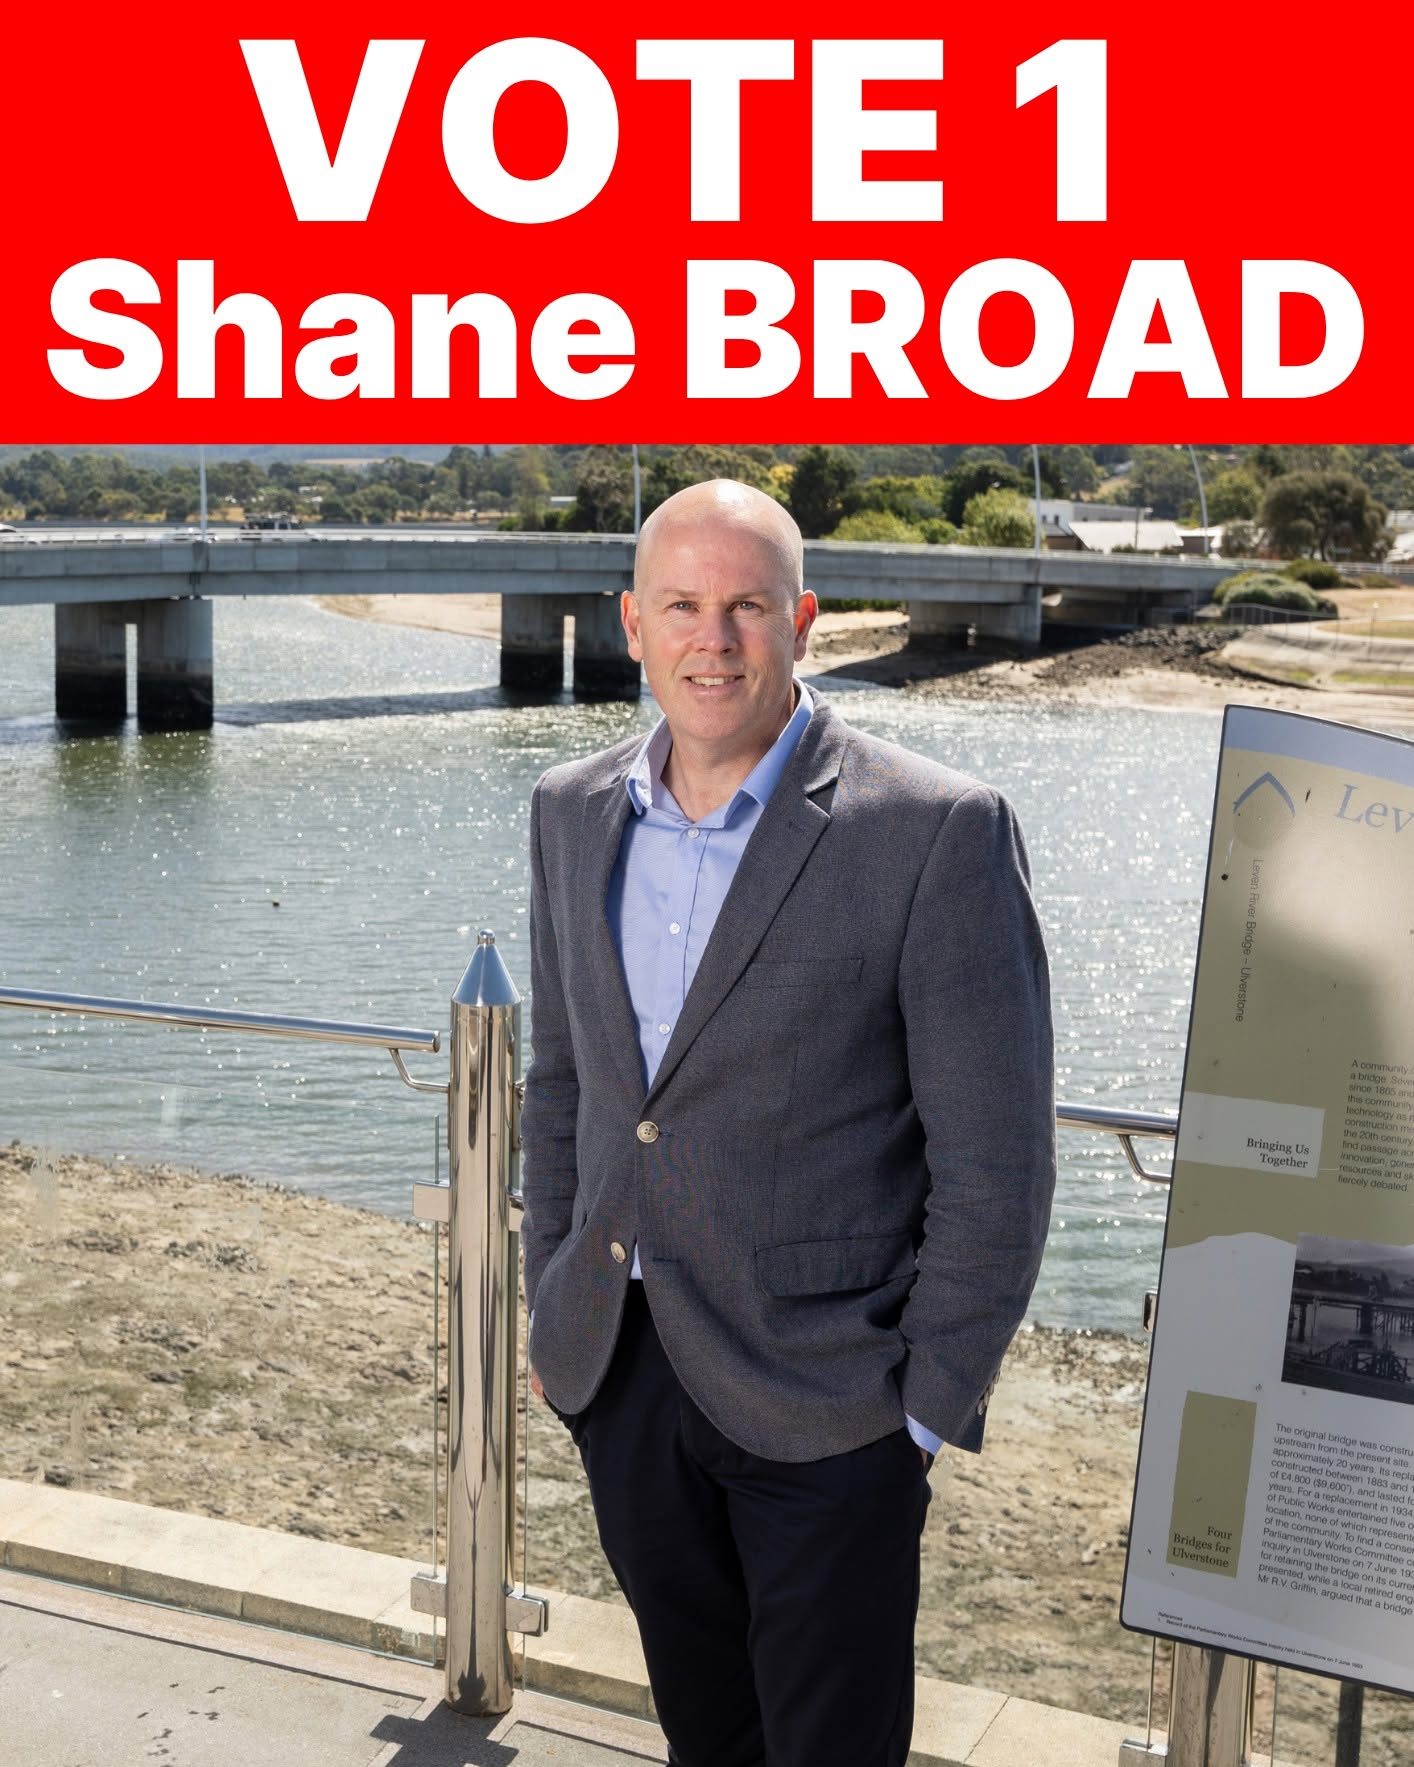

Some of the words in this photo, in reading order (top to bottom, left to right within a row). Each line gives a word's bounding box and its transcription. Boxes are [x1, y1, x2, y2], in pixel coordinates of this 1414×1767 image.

[1250, 859, 1264, 890] Leven
[1247, 893, 1259, 918] River
[1242, 921, 1256, 956] Bridge
[1235, 967, 1251, 1022] Ulverstone
[1350, 1072, 1356, 1080] a
[1352, 1059, 1358, 1068] A
[1361, 1062, 1408, 1075] community
[1348, 1095, 1363, 1103] this
[1349, 1084, 1371, 1093] since
[1345, 1119, 1398, 1132] construction
[1346, 1106, 1394, 1120] technology
[1246, 1138, 1292, 1154] Bringing
[1296, 1144, 1309, 1154] Us
[1344, 1129, 1357, 1138] the
[1360, 1131, 1379, 1141] 20th
[1260, 1152, 1308, 1168] Together
[1343, 1140, 1359, 1149] find
[1361, 1144, 1399, 1156] passage
[1338, 1174, 1368, 1188] fiercely
[1340, 1165, 1382, 1177] resources
[1384, 1170, 1402, 1179] and
[1276, 1423, 1292, 1434] The
[1294, 1428, 1326, 1440] original
[1328, 1434, 1357, 1447] bridge
[1359, 1441, 1377, 1450] was
[1273, 1448, 1333, 1467] approximately
[1336, 1459, 1347, 1468] 20
[1379, 1467, 1390, 1477] Its
[1274, 1437, 1316, 1450] upstream
[1318, 1443, 1338, 1455] from
[1340, 1448, 1354, 1458] the
[1357, 1452, 1391, 1465] present
[1270, 1471, 1279, 1479] of
[1358, 1488, 1375, 1497] and
[1377, 1490, 1405, 1504] lasted
[1271, 1459, 1323, 1475] constructed
[1325, 1469, 1363, 1483] between
[1367, 1476, 1388, 1488] 1883
[1391, 1482, 1408, 1492] and
[1267, 1494, 1276, 1502] of
[1279, 1495, 1305, 1508] Public
[1307, 1502, 1335, 1514] Works
[1337, 1509, 1388, 1525] entertained
[1390, 1518, 1405, 1529] five
[1298, 1487, 1312, 1497] For
[1314, 1491, 1320, 1499] a
[1322, 1492, 1378, 1511] replacement
[1380, 1503, 1388, 1512] in
[1207, 1525, 1232, 1540] Four
[1264, 1517, 1273, 1525] of
[1275, 1518, 1289, 1528] the
[1345, 1532, 1355, 1541] To
[1357, 1534, 1373, 1545] find
[1305, 1514, 1328, 1524] none
[1330, 1517, 1339, 1526] of
[1341, 1521, 1366, 1533] which
[1174, 1533, 1212, 1550] Bridges
[1215, 1542, 1232, 1554] for
[1263, 1527, 1322, 1548] Parliamentary
[1324, 1539, 1352, 1553] Works
[1355, 1546, 1404, 1564] Committee
[1172, 1547, 1229, 1568] Ulverstone
[1260, 1551, 1272, 1560] for
[1274, 1555, 1312, 1570] retaining
[1314, 1563, 1328, 1572] the
[1331, 1566, 1360, 1579] bridge
[1362, 1573, 1373, 1582] on
[1376, 1575, 1386, 1585] its
[1262, 1540, 1291, 1553] inquiry
[1293, 1546, 1301, 1555] in
[1303, 1549, 1350, 1565] Ulverstone
[1352, 1560, 1364, 1569] on
[1374, 1564, 1397, 1575] June
[1258, 1574, 1269, 1584] Mr
[1271, 1576, 1288, 1588] R.V.
[1290, 1580, 1318, 1595] Griffin,
[1321, 1588, 1353, 1602] argued
[1356, 1595, 1372, 1607] that
[1383, 1601, 1413, 1616] bridge
[1307, 1573, 1331, 1585] while
[1332, 1579, 1339, 1587] a
[1341, 1581, 1362, 1592] local
[1364, 1586, 1393, 1599] retired
